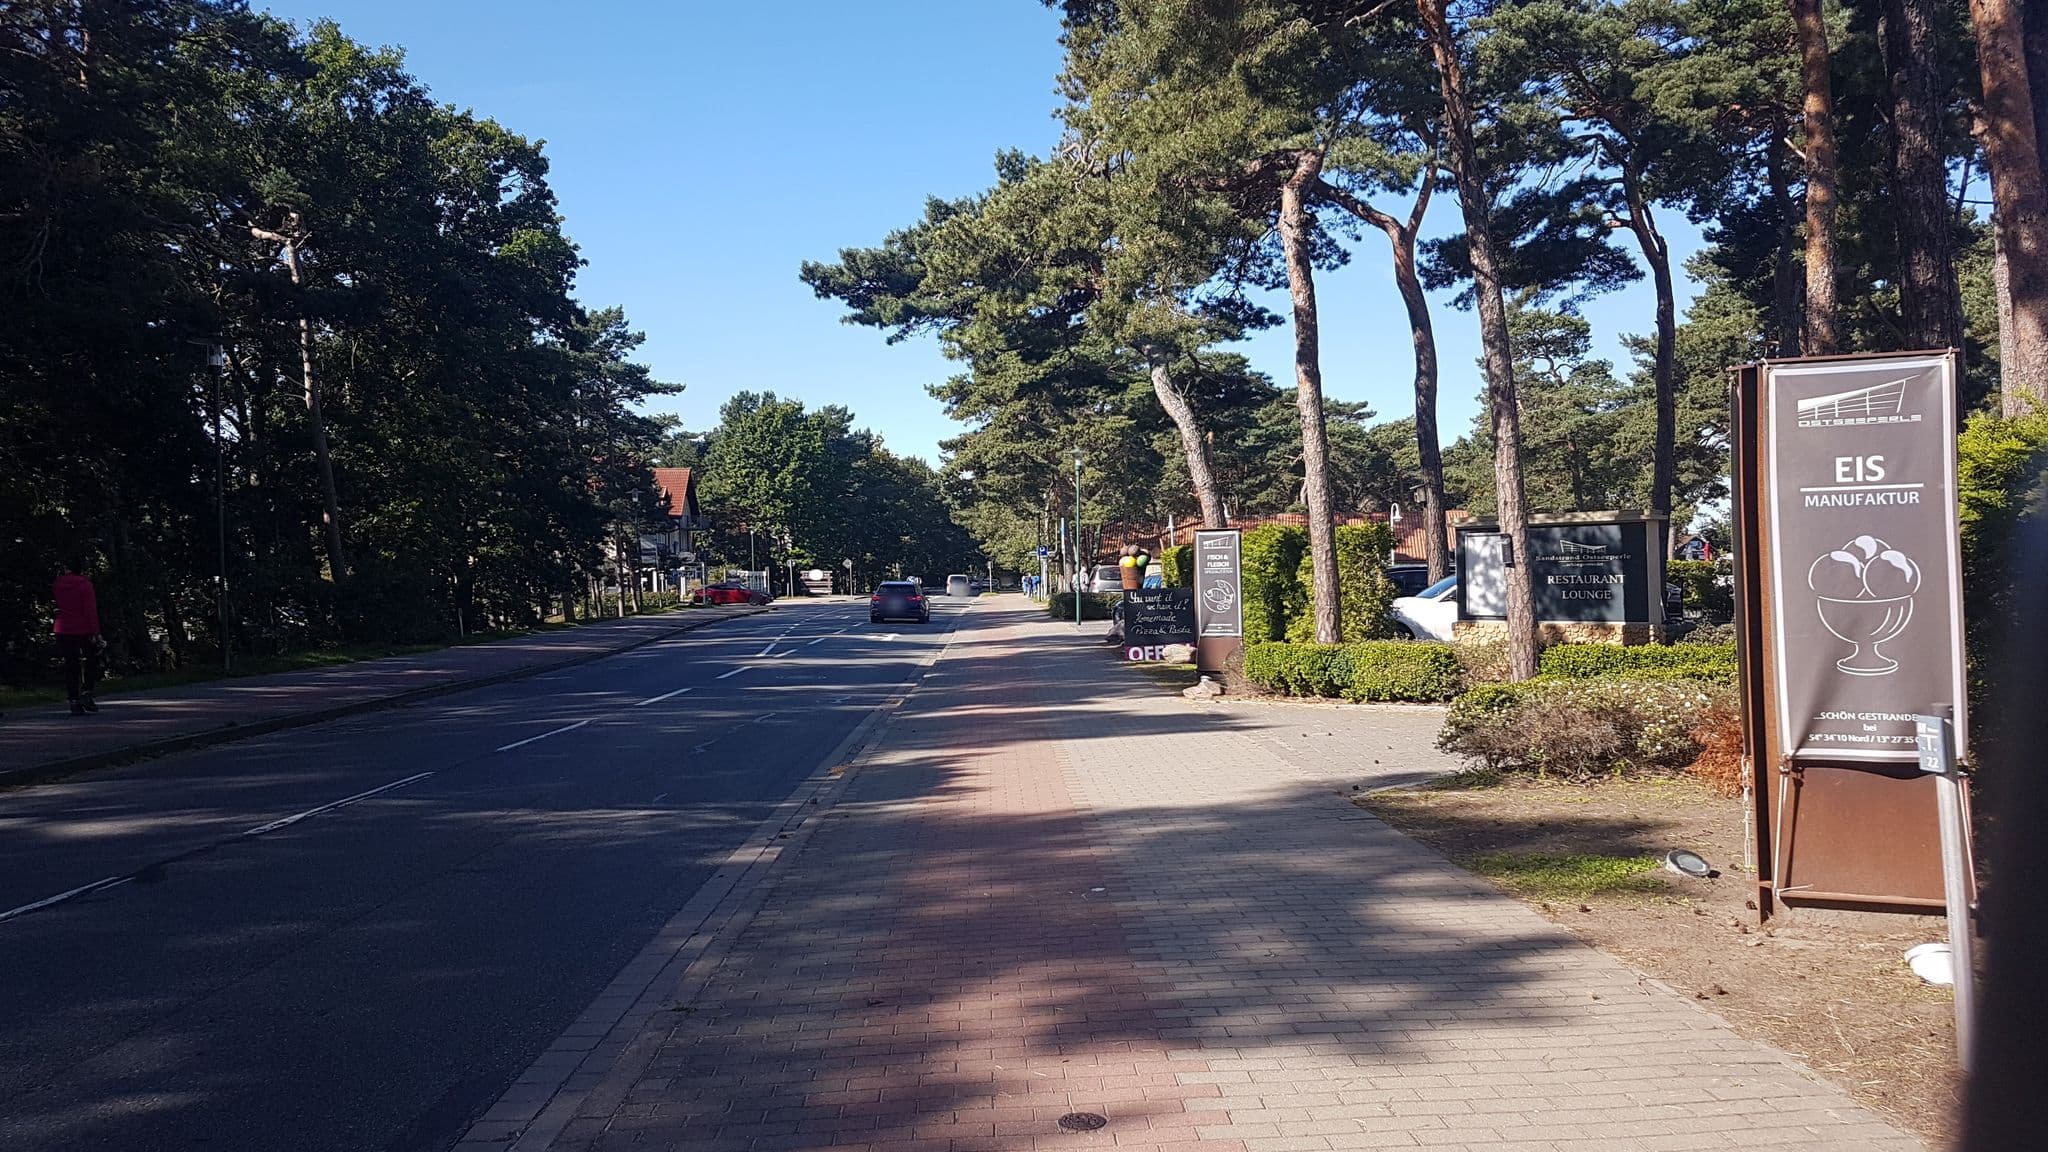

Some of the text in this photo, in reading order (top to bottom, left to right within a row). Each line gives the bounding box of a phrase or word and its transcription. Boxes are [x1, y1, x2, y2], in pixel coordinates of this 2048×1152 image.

[1798, 414, 1922, 428] OSTSEEPERLE
[1835, 454, 1886, 483] EIS
[1804, 491, 1920, 508] MANUFAKTUR
[1547, 574, 1626, 585] RESTAURANT
[1129, 591, 1144, 604] You
[1562, 590, 1612, 600] LOUNGE
[1857, 713, 1920, 722] GESTRANDE
[1863, 724, 1877, 732] bei
[1848, 734, 1869, 743] Nord
[1926, 757, 1939, 768] 22
